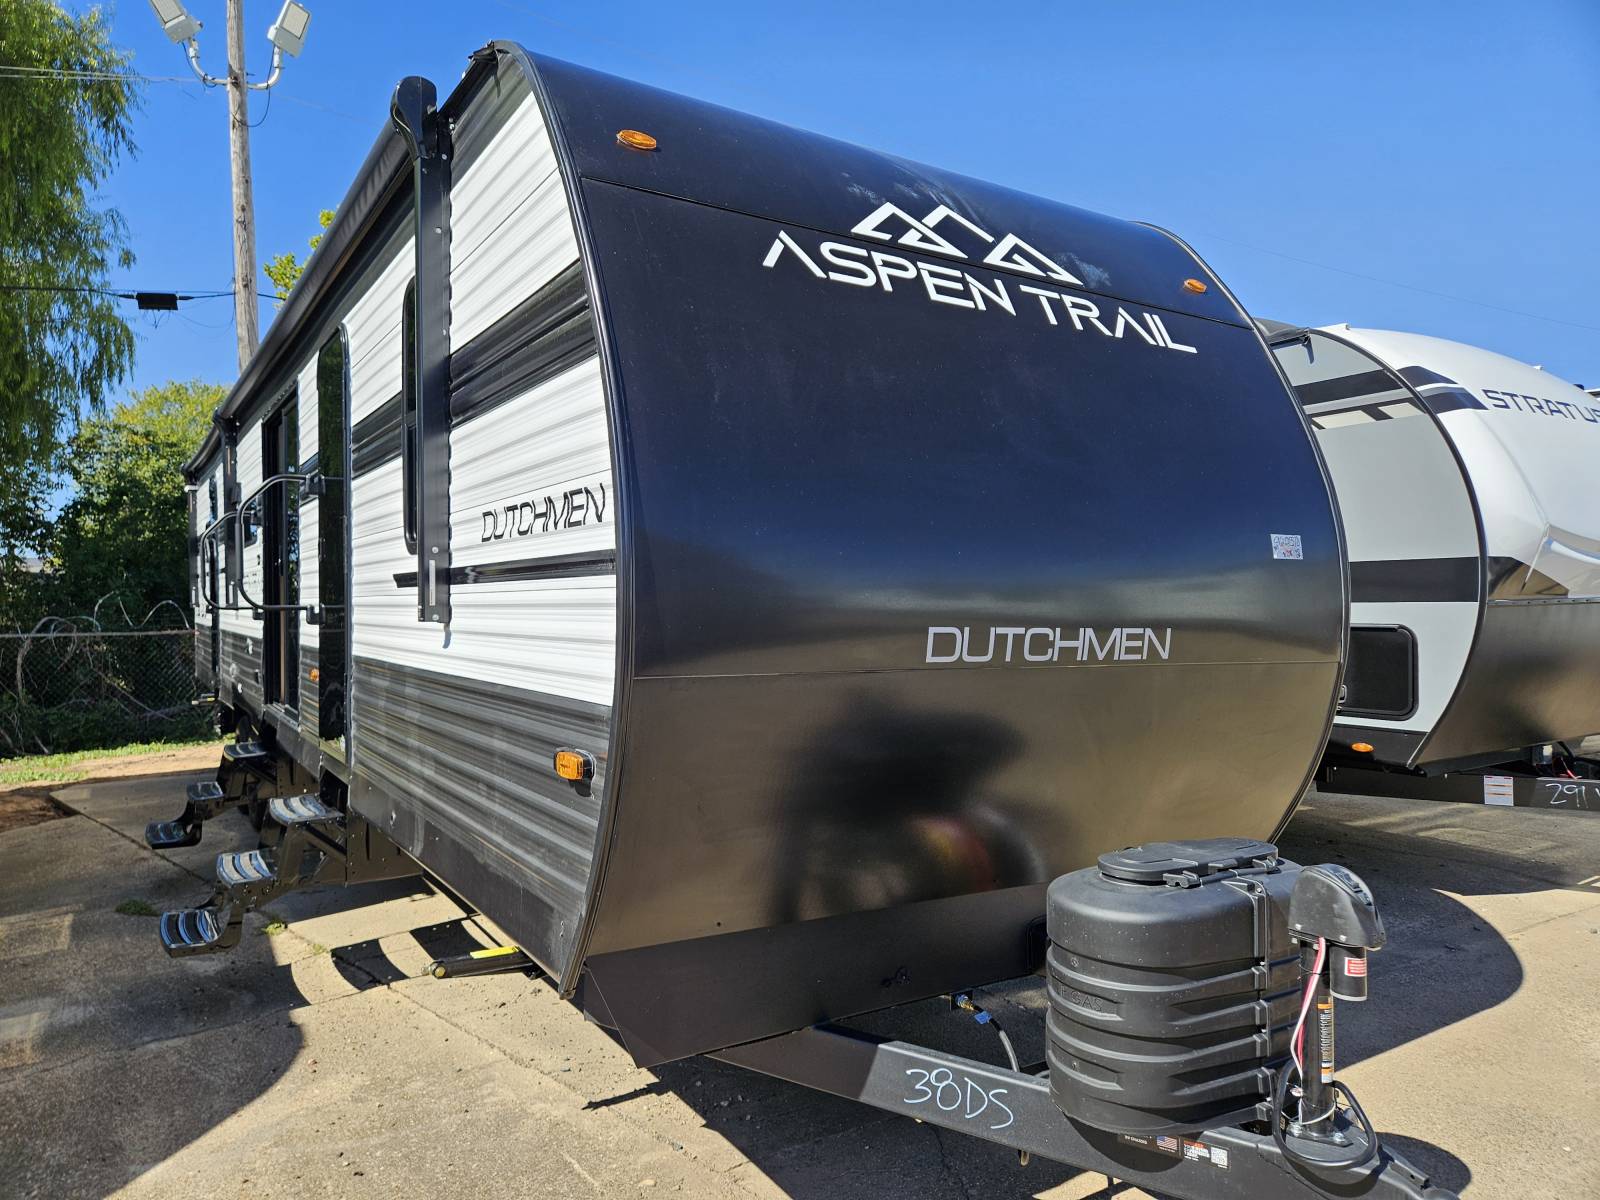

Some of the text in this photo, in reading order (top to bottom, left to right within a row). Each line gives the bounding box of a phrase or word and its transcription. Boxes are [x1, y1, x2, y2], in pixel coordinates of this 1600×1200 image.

[763, 230, 1198, 354] ASPEN TRAIL
[481, 482, 606, 543] DUTCHMEN
[925, 626, 1172, 663] DUTCHMEN
[903, 1068, 1014, 1129] 38DS
